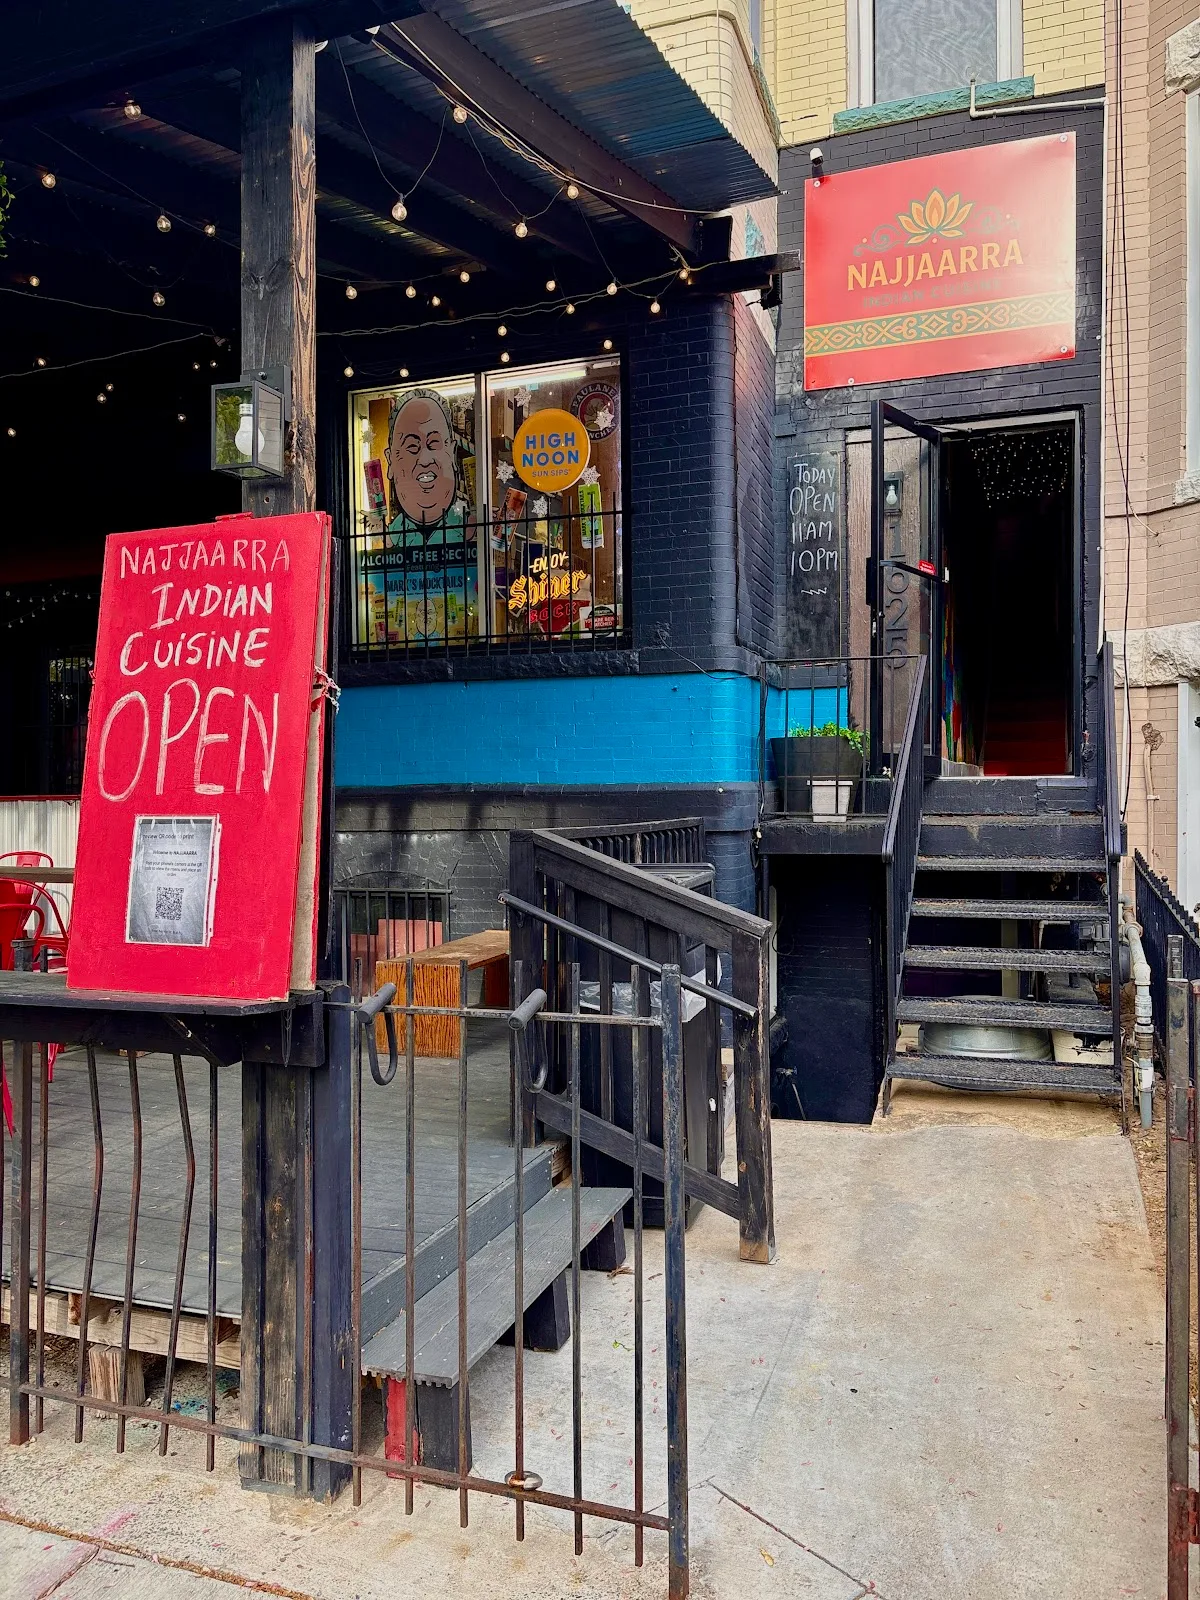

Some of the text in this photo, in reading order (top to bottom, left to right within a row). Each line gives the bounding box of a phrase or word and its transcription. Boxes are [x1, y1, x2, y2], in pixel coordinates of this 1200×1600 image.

[847, 238, 1024, 291] NAJJAARRA
[863, 278, 1001, 309] INDIAN CUISINE
[525, 432, 575, 450] HIGH
[522, 450, 579, 468] NOON
[532, 469, 569, 478] SUN SIPS
[789, 486, 836, 515] OPEN
[119, 538, 291, 579] NAJJAARRA
[532, 551, 567, 574] ENOY
[791, 547, 839, 576] 10PM
[508, 569, 588, 610] Shiner
[98, 677, 280, 801] OPEN
